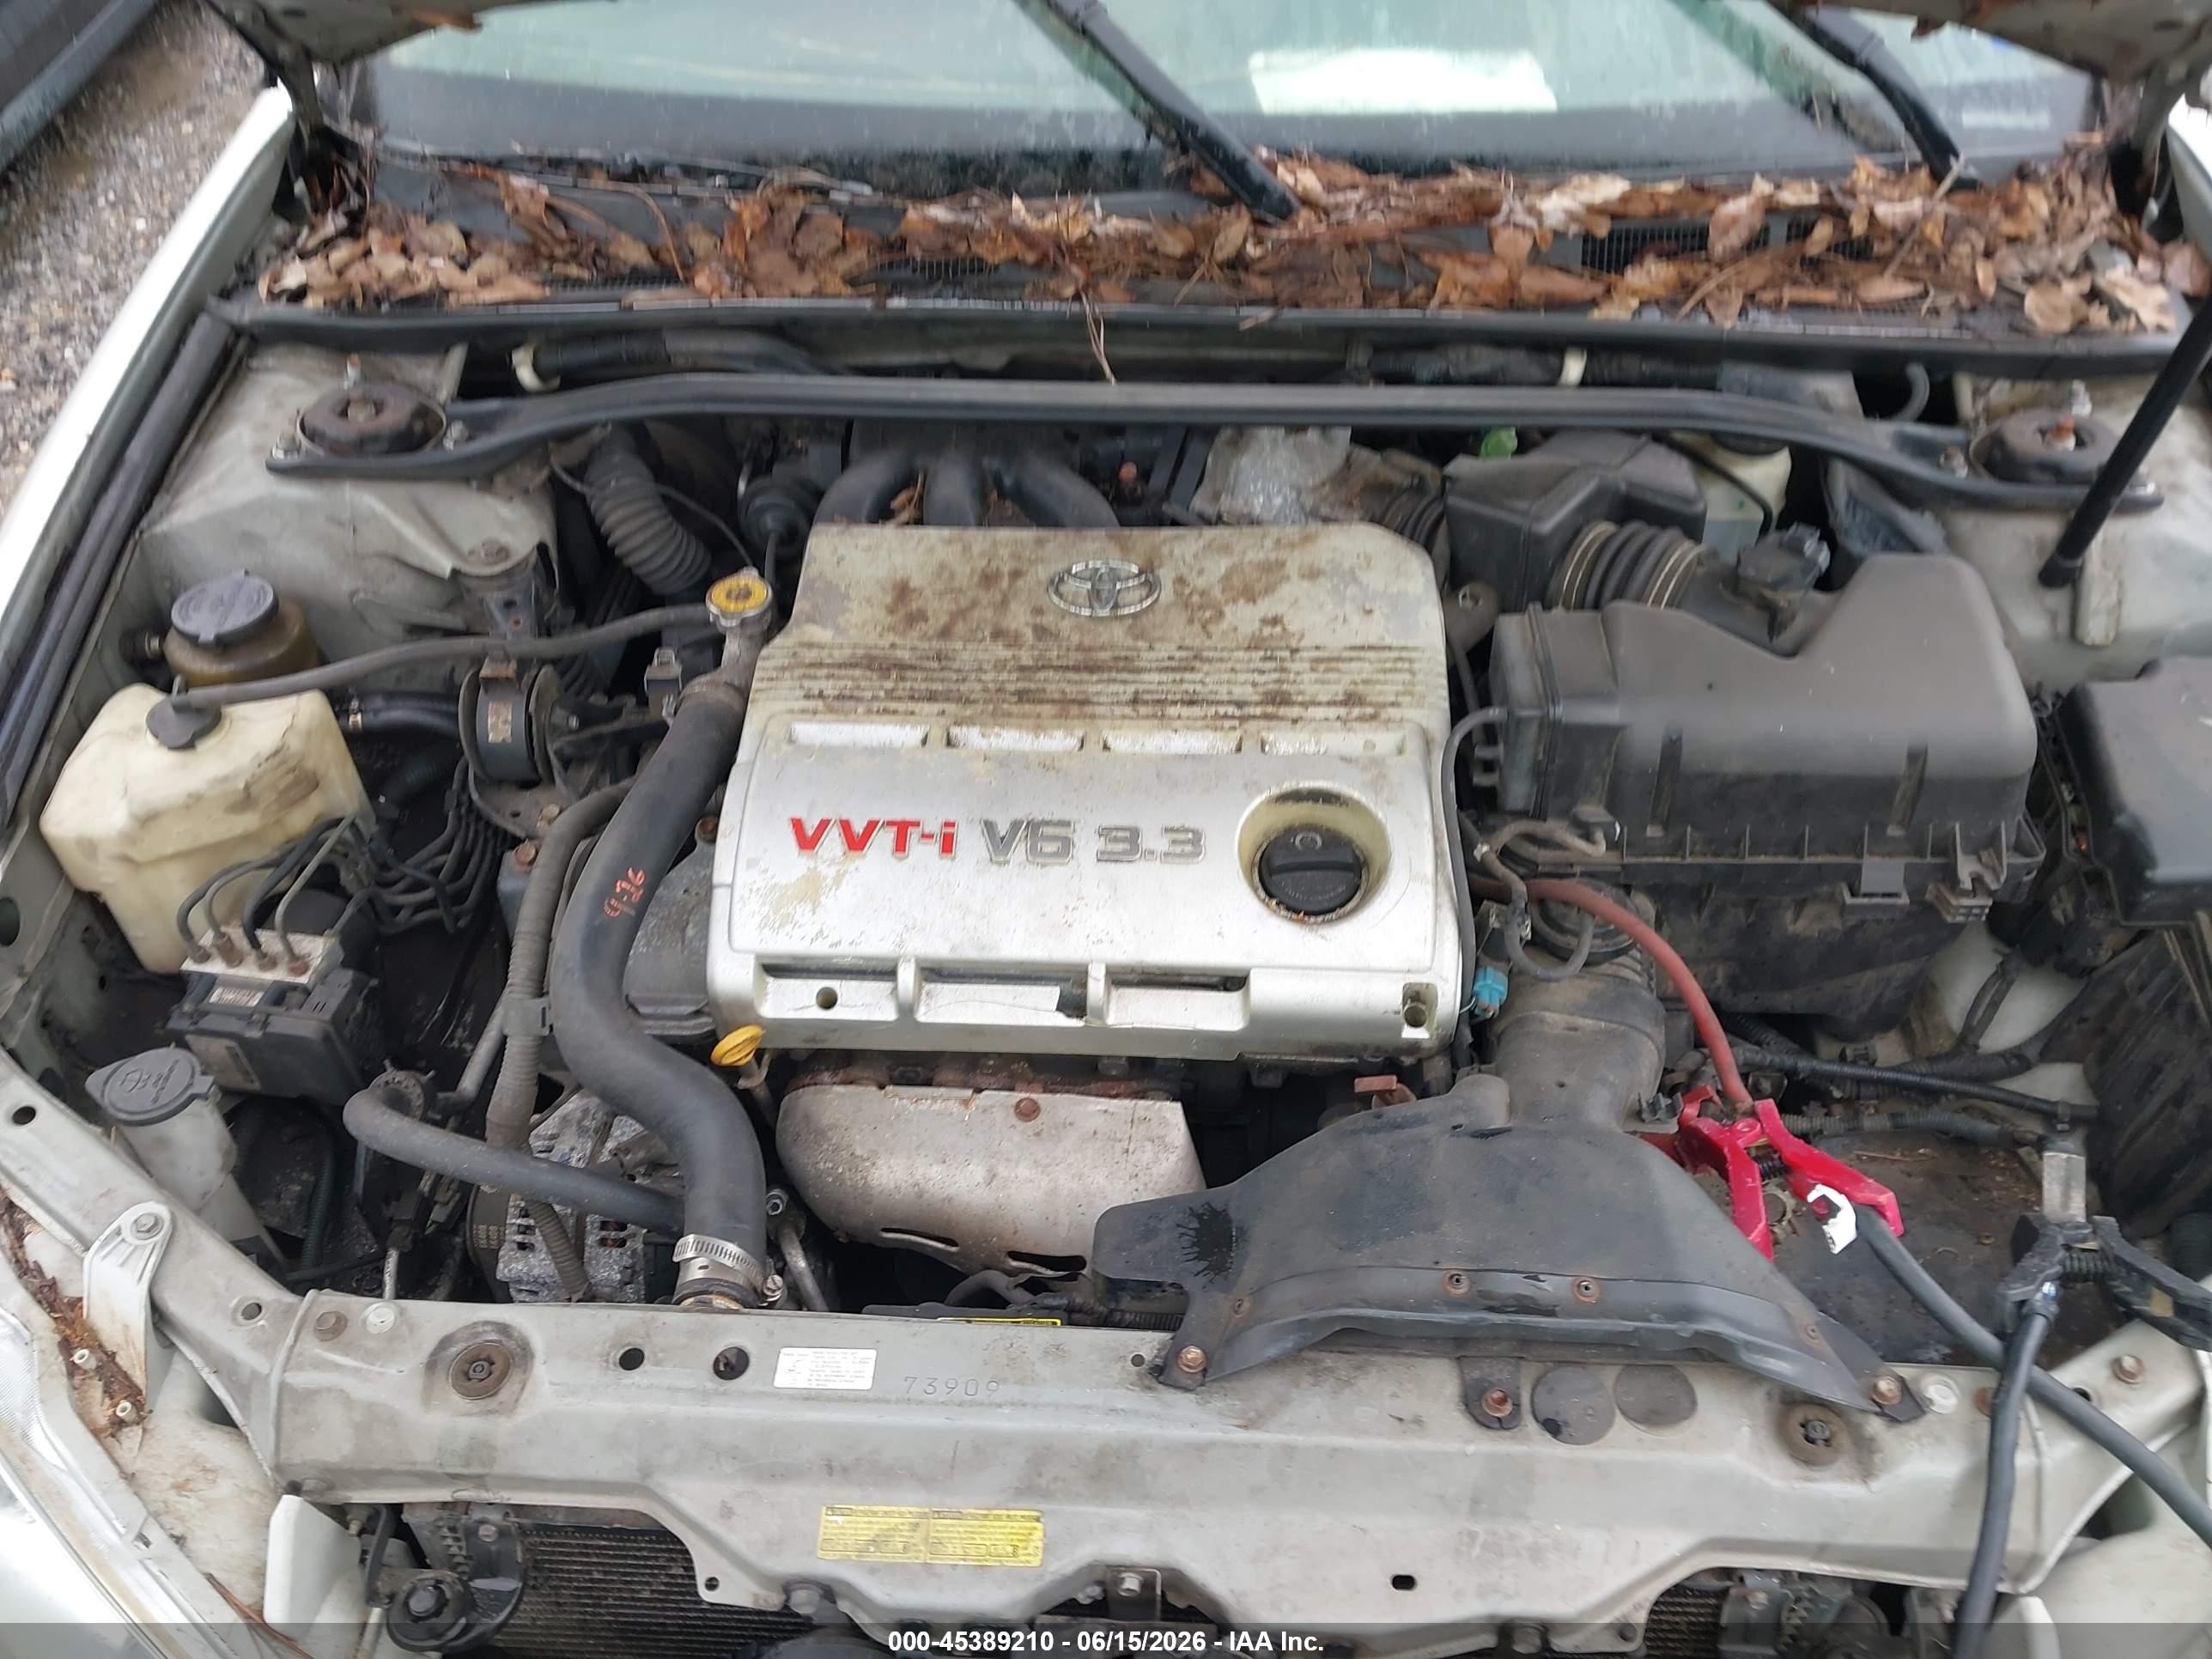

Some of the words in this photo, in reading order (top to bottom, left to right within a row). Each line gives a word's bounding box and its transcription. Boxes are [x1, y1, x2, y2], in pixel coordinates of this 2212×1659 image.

[790, 817, 959, 859] VVT-i
[980, 818, 1075, 863] V6
[1097, 824, 1206, 862] 3.3
[903, 1376, 1001, 1398] 73909
